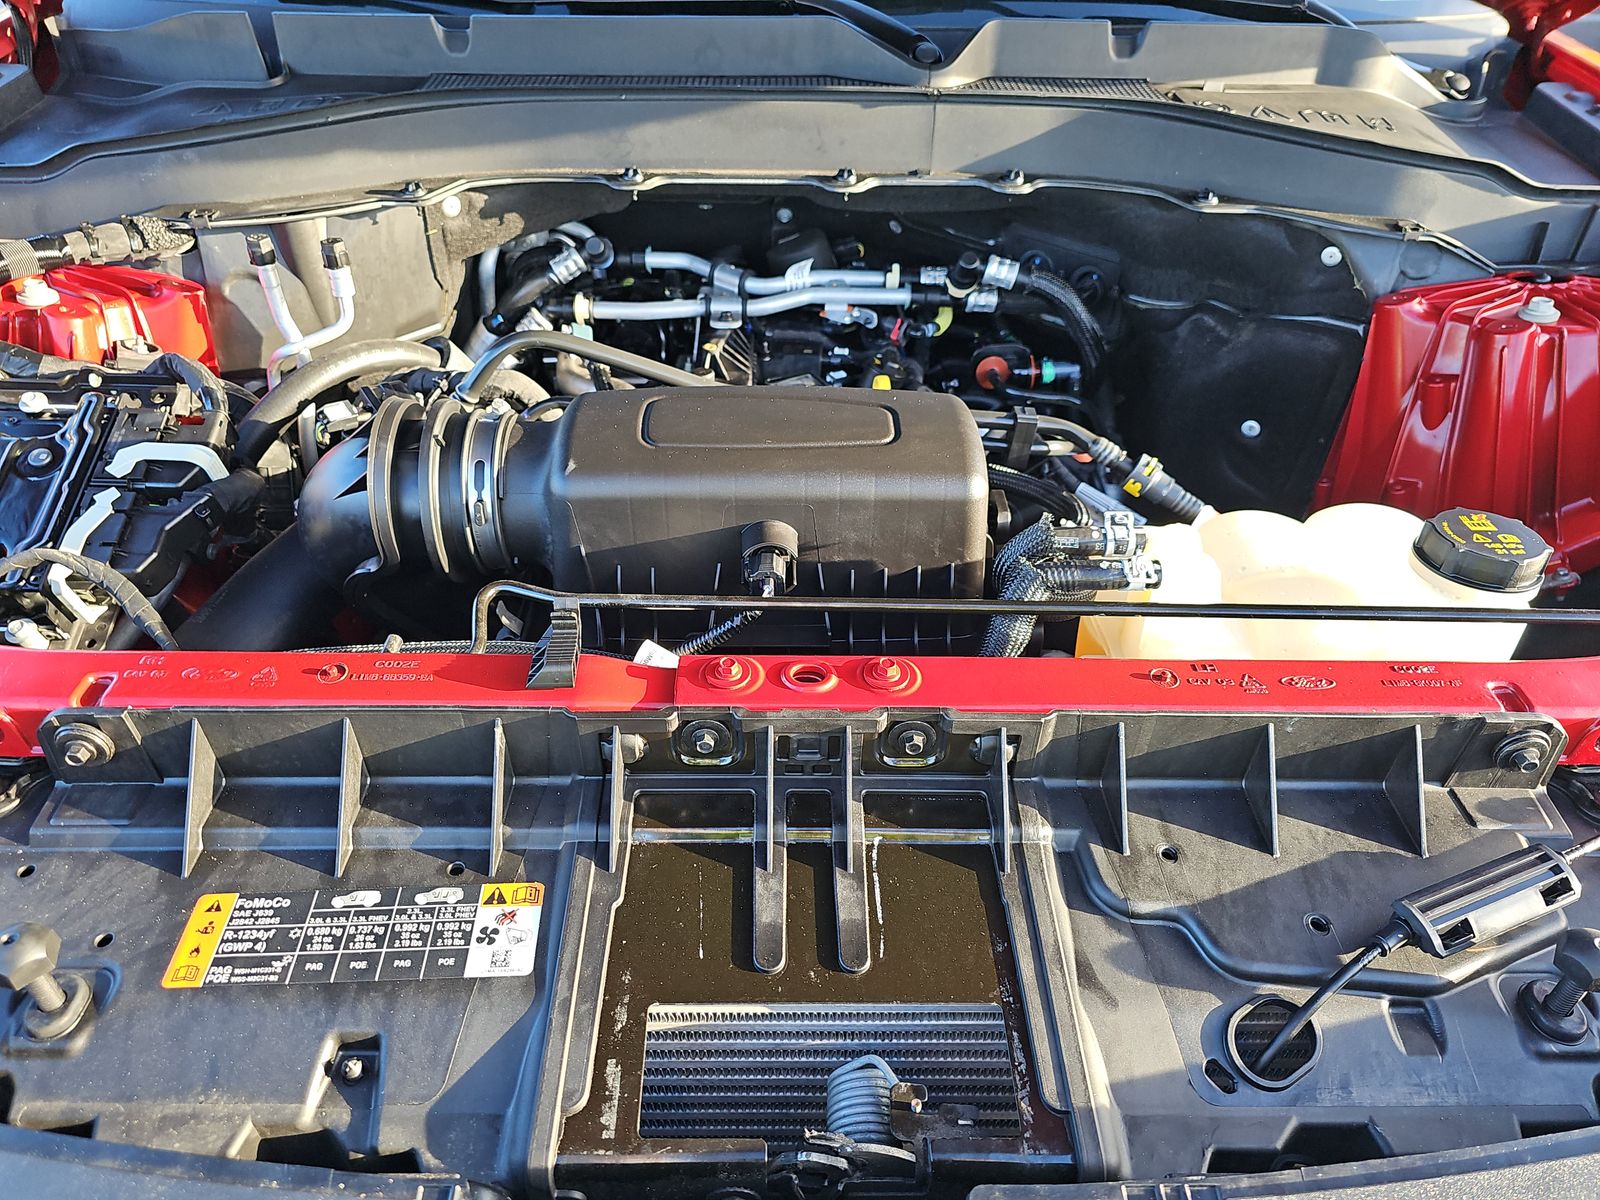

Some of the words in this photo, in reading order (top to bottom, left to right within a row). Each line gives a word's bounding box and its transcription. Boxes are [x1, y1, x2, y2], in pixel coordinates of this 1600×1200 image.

[1190, 663, 1219, 672] LH
[235, 897, 291, 909] FoMoCo
[232, 910, 252, 918] SAE
[252, 909, 274, 917] J639
[228, 918, 254, 926] J2842
[255, 917, 281, 925] J2845
[349, 925, 373, 935] 0.737
[373, 925, 385, 935] kg
[394, 923, 418, 932] 0.992
[418, 923, 431, 933] kg
[436, 922, 460, 931] 0.992
[460, 922, 472, 932] kg
[223, 929, 277, 940] R-1234yf
[331, 927, 343, 937] kg
[394, 940, 410, 948] 2.19
[410, 939, 422, 947] lbs
[436, 938, 452, 946] 2.19
[452, 938, 465, 946] lbs
[218, 942, 254, 954] (GWP
[253, 941, 267, 953] 4)
[349, 961, 368, 969] POE
[393, 959, 412, 968] PAG
[437, 958, 456, 966] POE
[209, 965, 233, 975] PAG
[305, 963, 323, 971] PAG
[204, 974, 230, 984] POE
